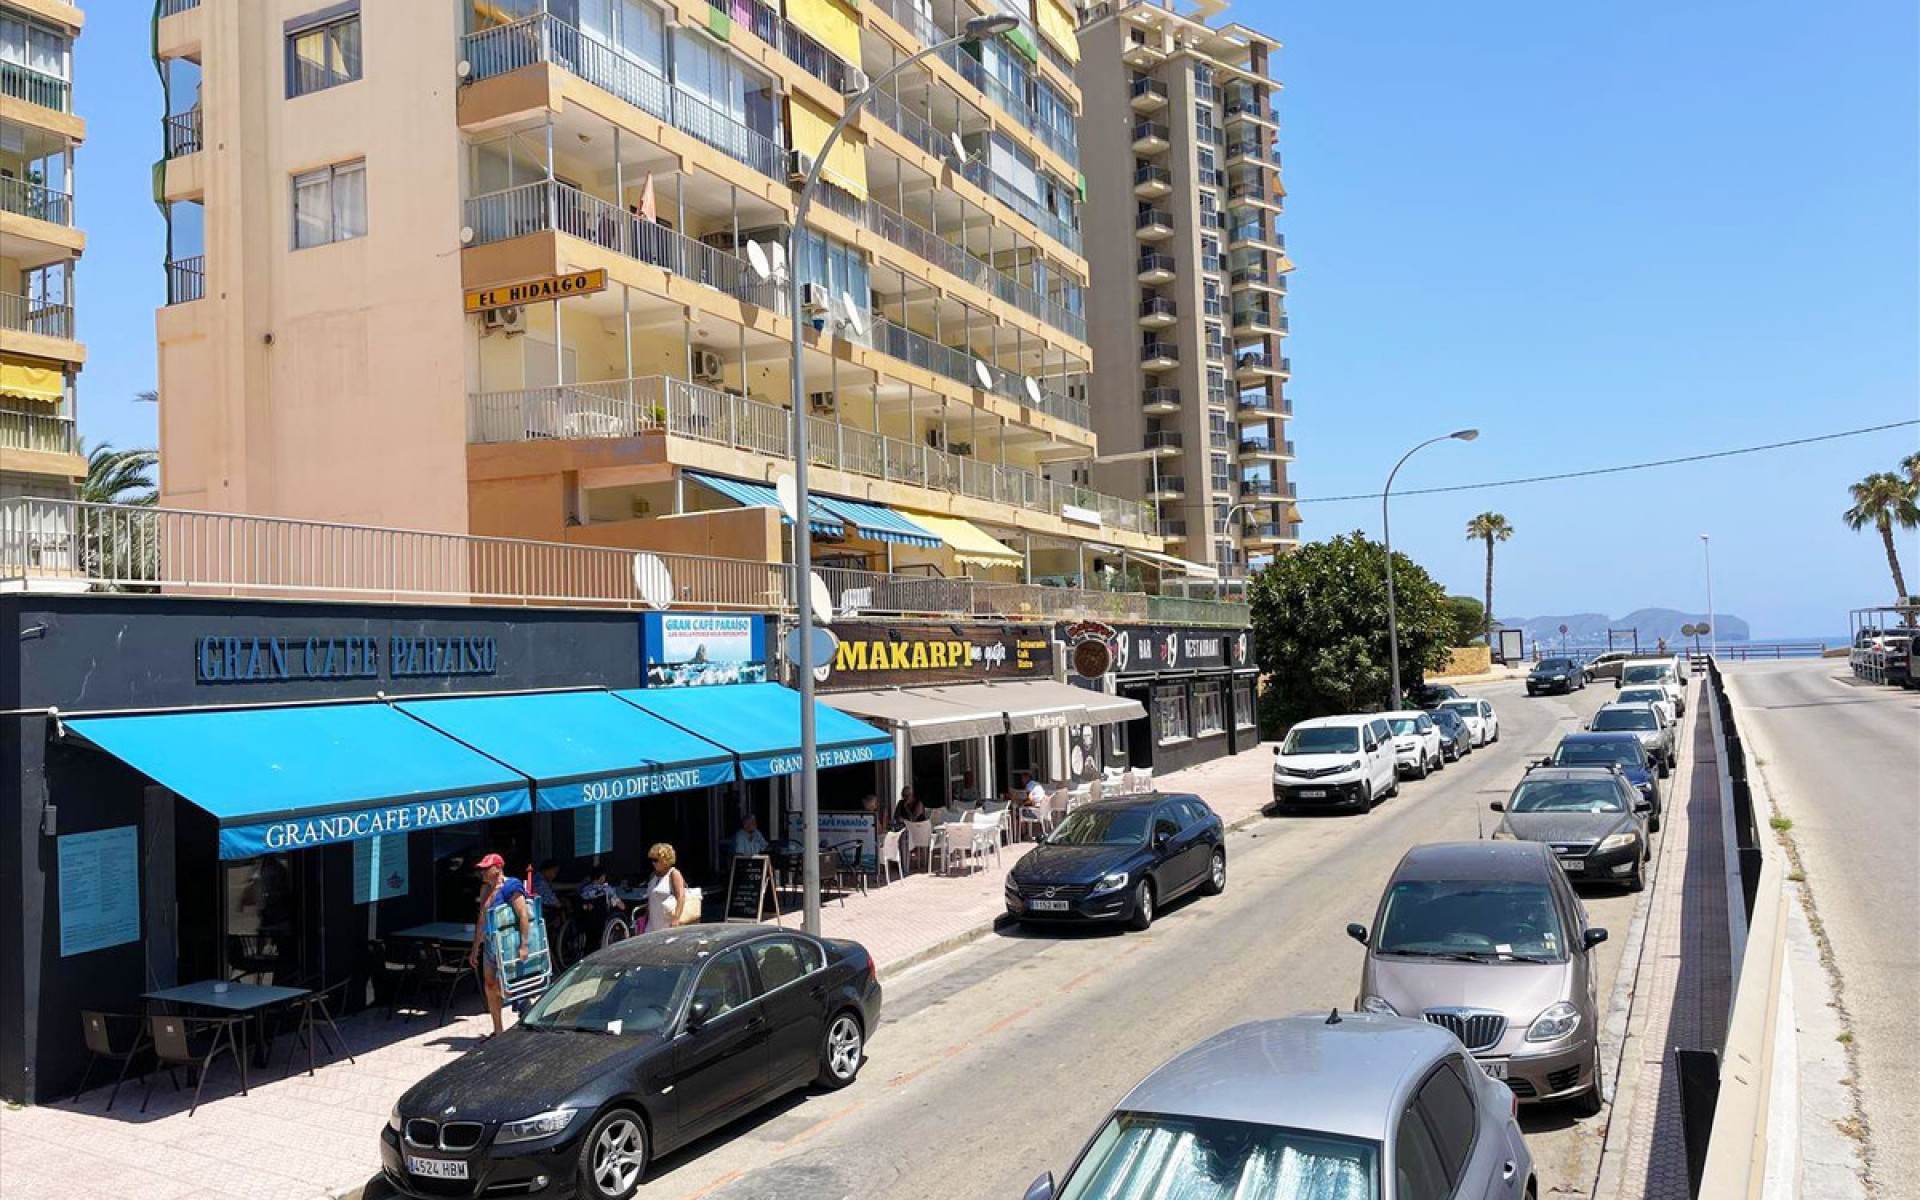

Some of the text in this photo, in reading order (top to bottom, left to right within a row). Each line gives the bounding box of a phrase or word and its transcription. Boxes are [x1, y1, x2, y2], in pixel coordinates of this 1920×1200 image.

[480, 276, 587, 305] EL HIDALGO
[666, 619, 691, 630] GRAN
[199, 635, 498, 680] GRAN CAFE PARAISO
[836, 641, 973, 671] MAKARPI
[1138, 638, 1152, 659] BAR
[833, 746, 873, 769] PARAISO
[583, 769, 700, 802] SOLO DIFERENTE
[266, 796, 500, 849] GRANDCAFE PARAISO
